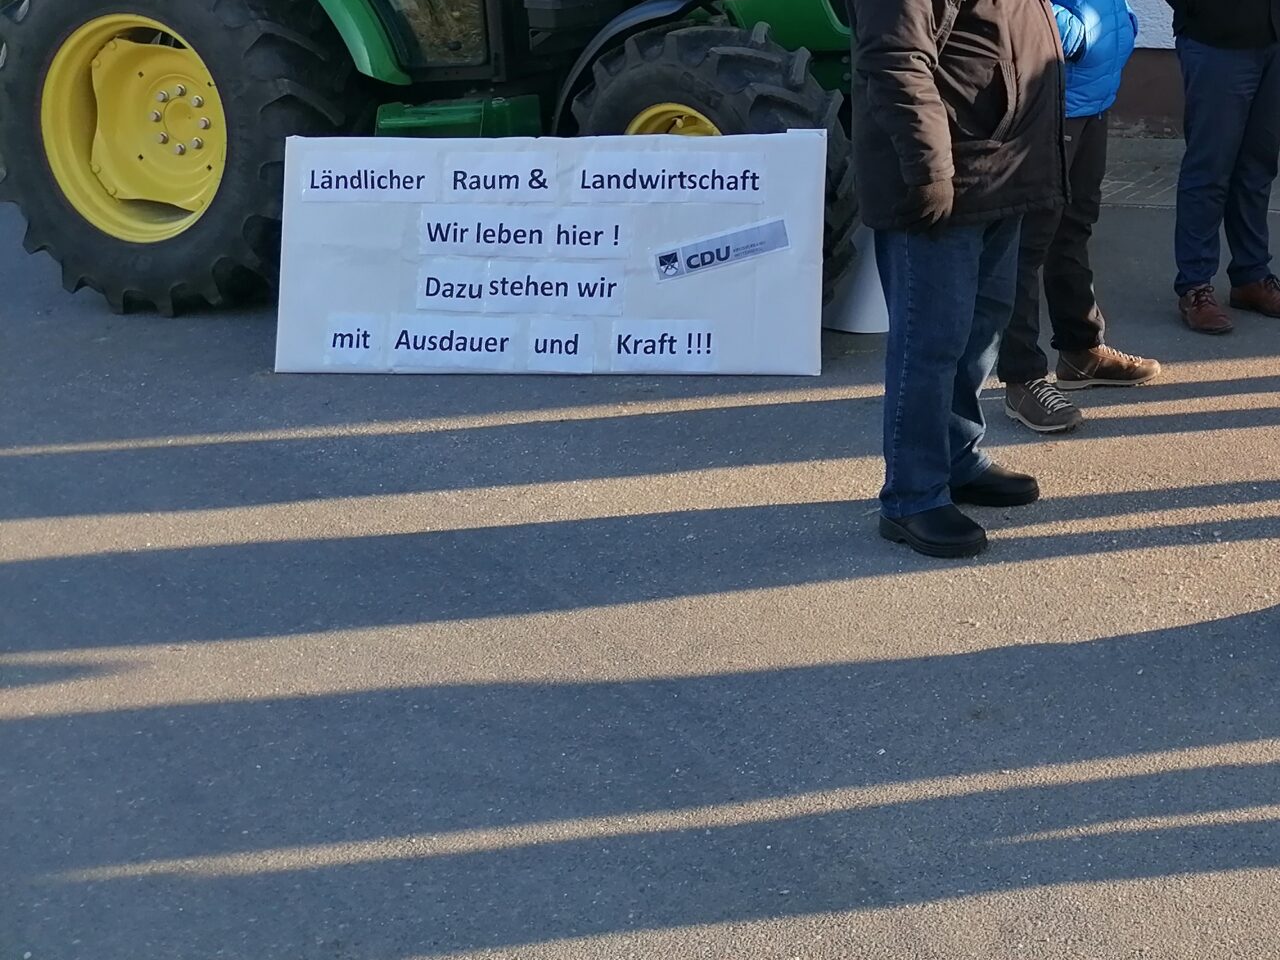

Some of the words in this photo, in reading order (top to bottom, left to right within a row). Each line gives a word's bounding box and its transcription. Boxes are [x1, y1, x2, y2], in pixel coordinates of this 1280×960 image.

[310, 169, 426, 190] Ländlicher
[453, 170, 520, 191] Raum
[528, 168, 549, 190] &
[581, 168, 760, 192] Landwirtschaft
[427, 221, 469, 243] Wir
[476, 222, 543, 245] leben
[556, 223, 604, 246] hier
[613, 224, 620, 246] !
[686, 245, 731, 269] CDU
[425, 276, 483, 299] Dazu
[489, 274, 569, 297] stehen
[577, 276, 618, 298] wir
[332, 327, 371, 349] mit
[394, 329, 510, 353] Ausdauer
[534, 333, 579, 356] und
[617, 332, 678, 355] Kraft
[687, 332, 713, 355] !!!
